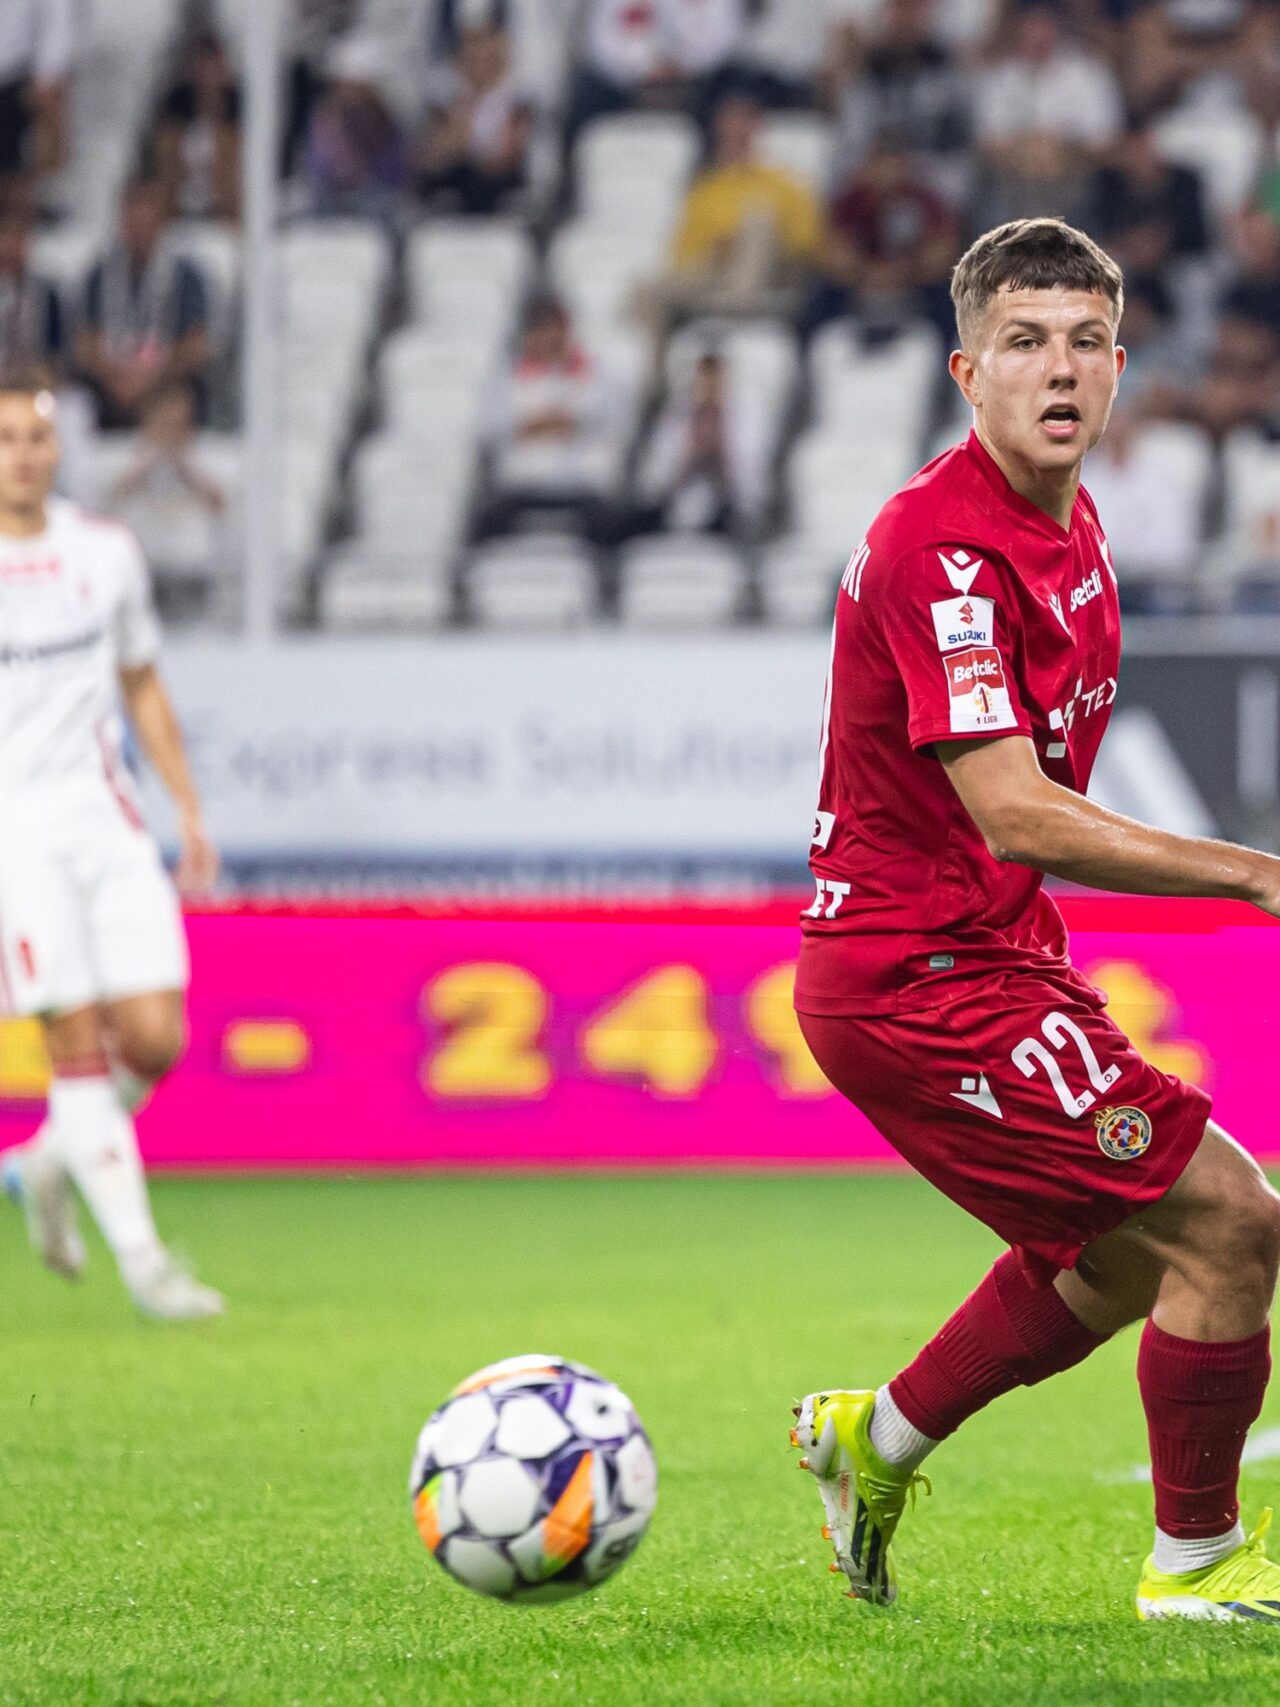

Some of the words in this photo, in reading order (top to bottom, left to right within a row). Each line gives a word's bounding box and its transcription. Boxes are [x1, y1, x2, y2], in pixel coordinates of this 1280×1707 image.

[947, 630, 986, 644] SUZUKI
[953, 658, 999, 684] Betclic
[1011, 1011, 1122, 1119] 22
